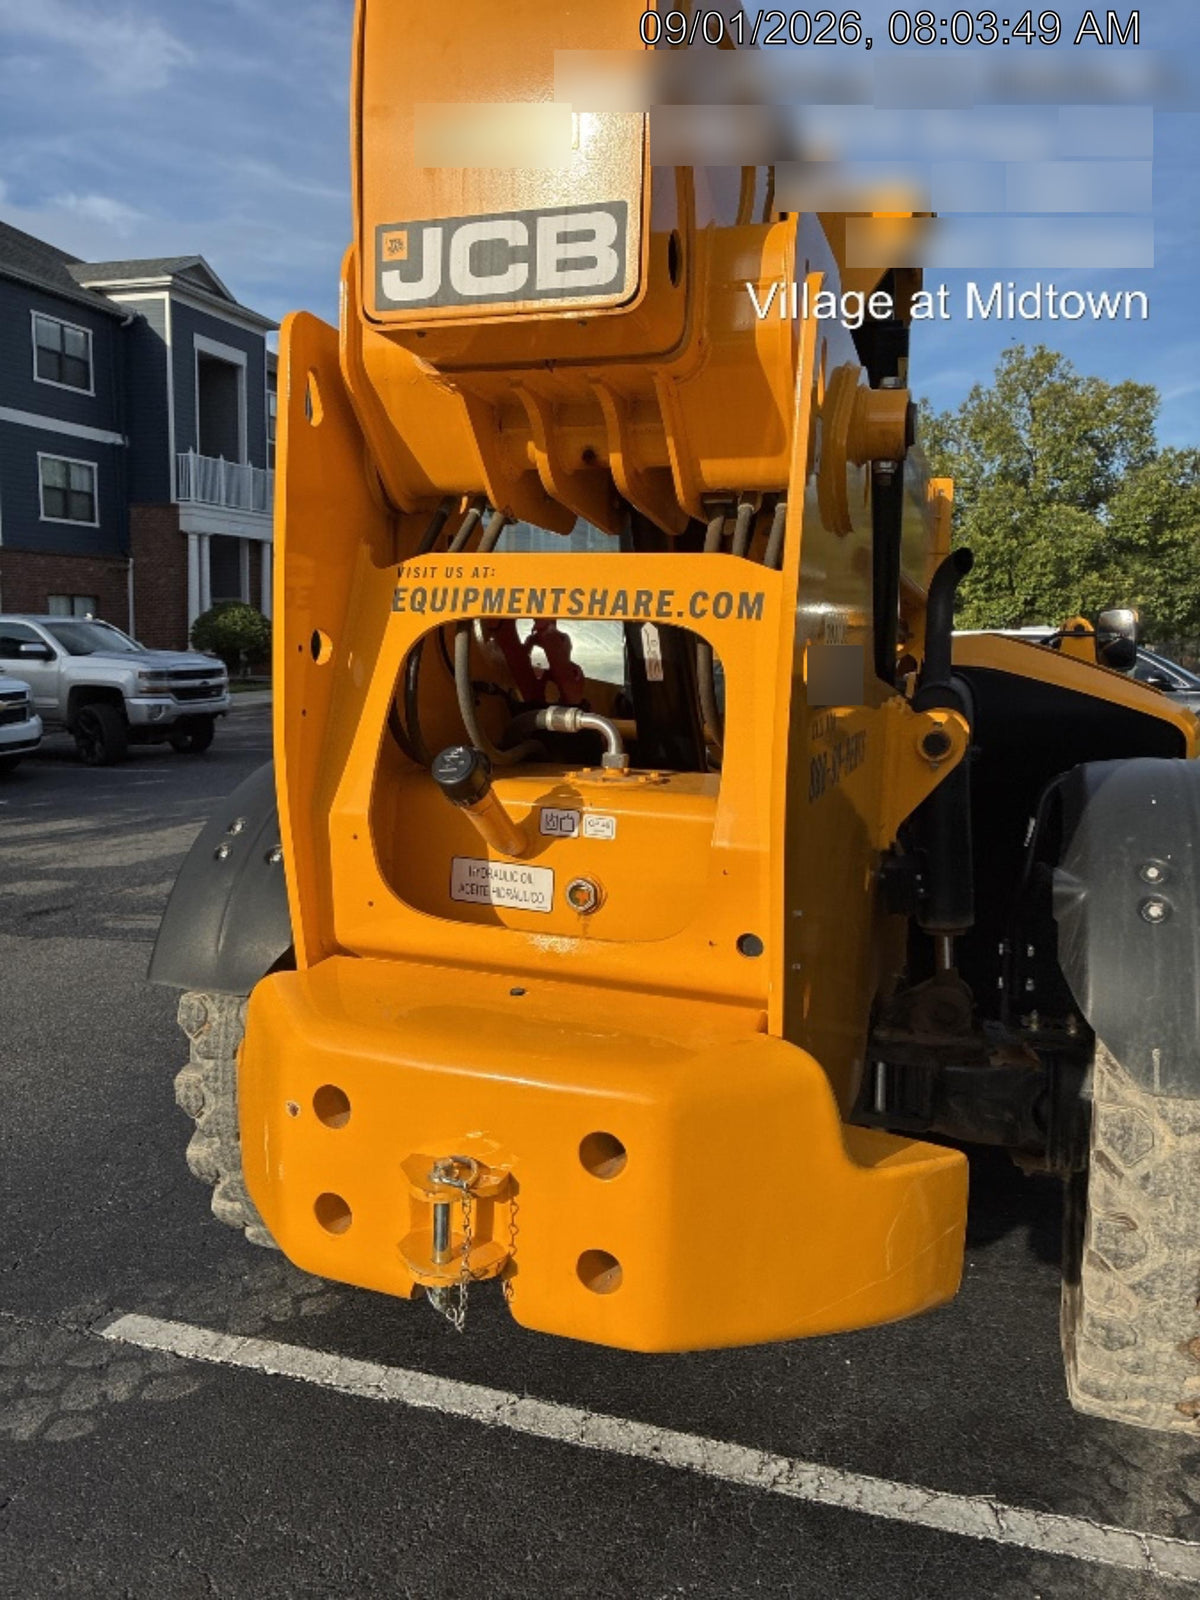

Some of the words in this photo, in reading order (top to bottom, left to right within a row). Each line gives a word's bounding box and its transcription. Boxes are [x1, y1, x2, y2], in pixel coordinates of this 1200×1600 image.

[381, 210, 620, 302] JCB
[397, 566, 438, 579] VISIT
[445, 566, 464, 579] US
[471, 566, 496, 579] AT:
[391, 586, 765, 621] EQUIPMENTSHARE.COM
